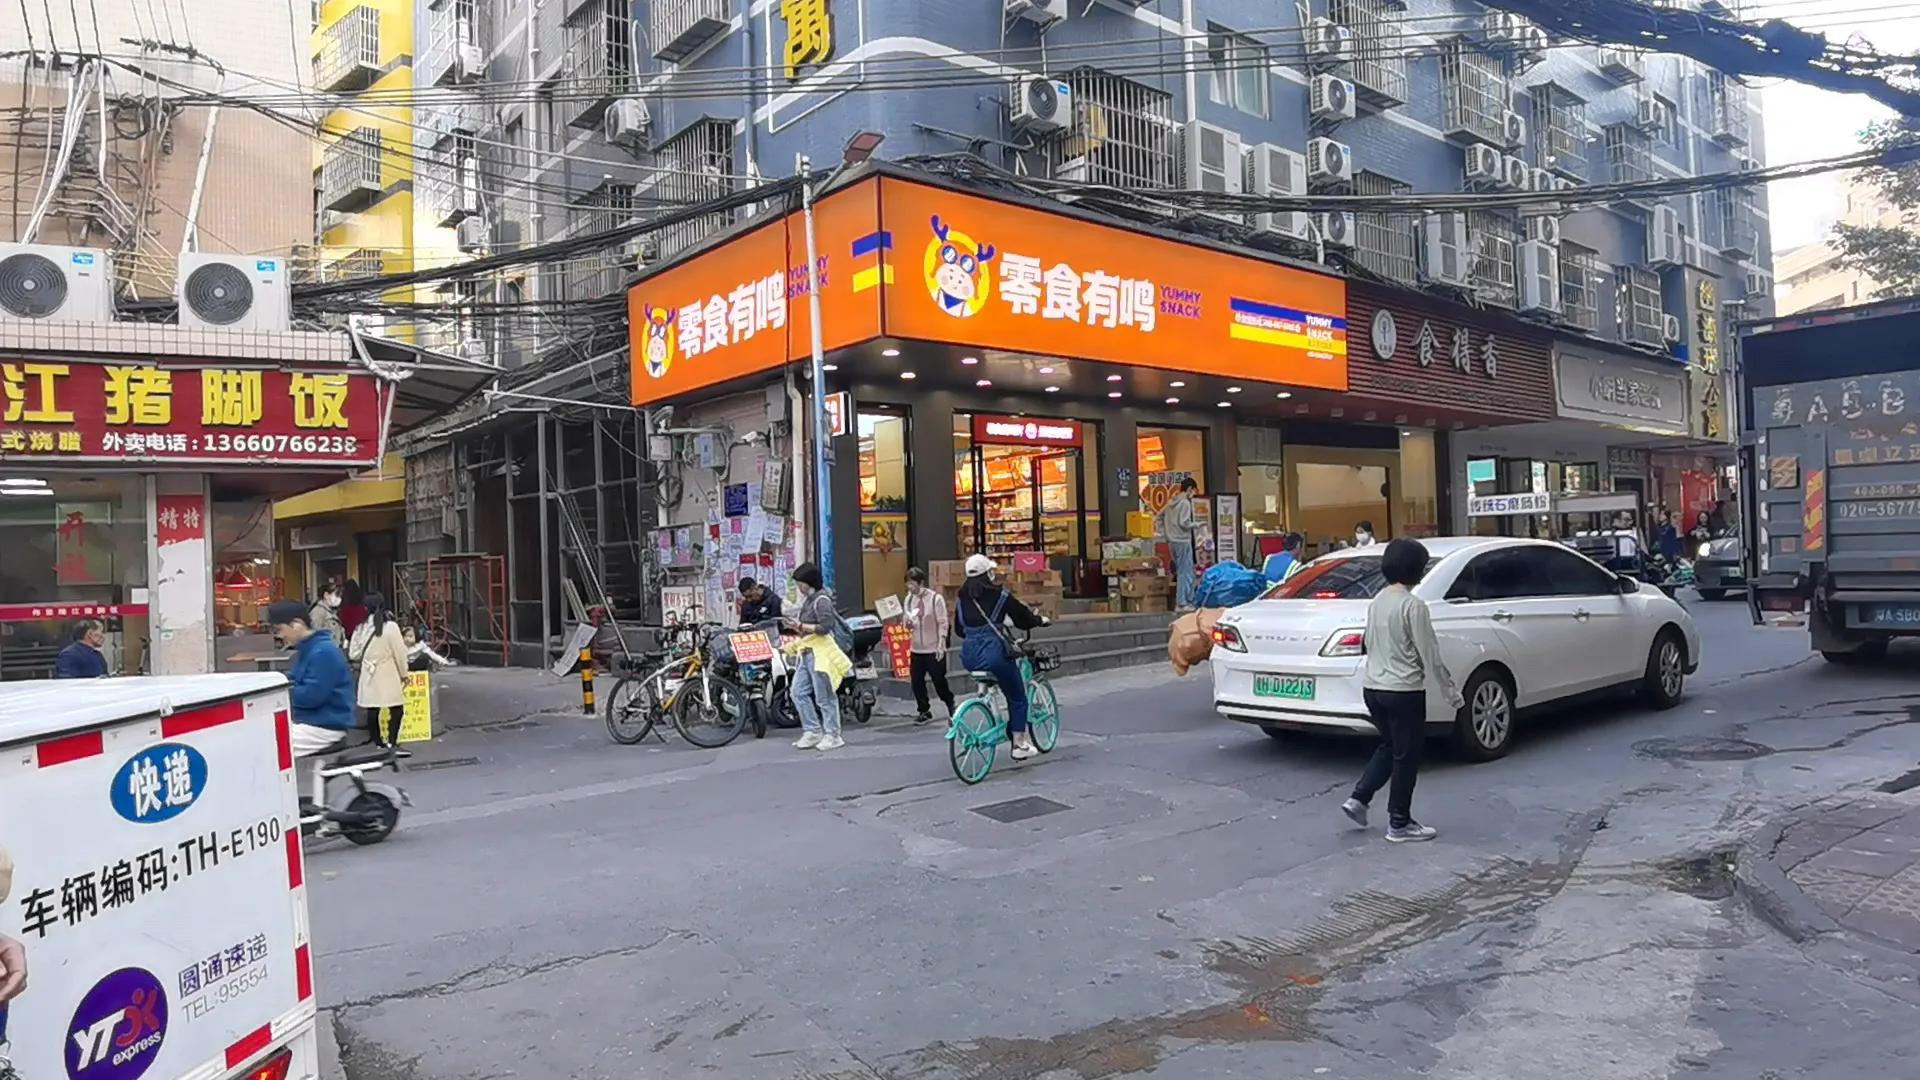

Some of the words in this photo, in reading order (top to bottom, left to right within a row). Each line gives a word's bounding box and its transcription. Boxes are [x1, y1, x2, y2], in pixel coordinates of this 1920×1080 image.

[788, 255, 829, 283] YUY
[788, 271, 829, 298] SNK
[998, 251, 1156, 332] 零食有鸣
[1160, 285, 1201, 304] YUMMY
[677, 268, 786, 360] 零食有鸣
[1160, 300, 1201, 319] SNACK
[1409, 318, 1500, 379] 食得香
[2, 362, 350, 430] 江猪脚饭
[129, 748, 194, 818] 快递
[177, 933, 269, 999] 圆通速递
[181, 966, 270, 1024] TEL:95554
[112, 1030, 162, 1066] express
